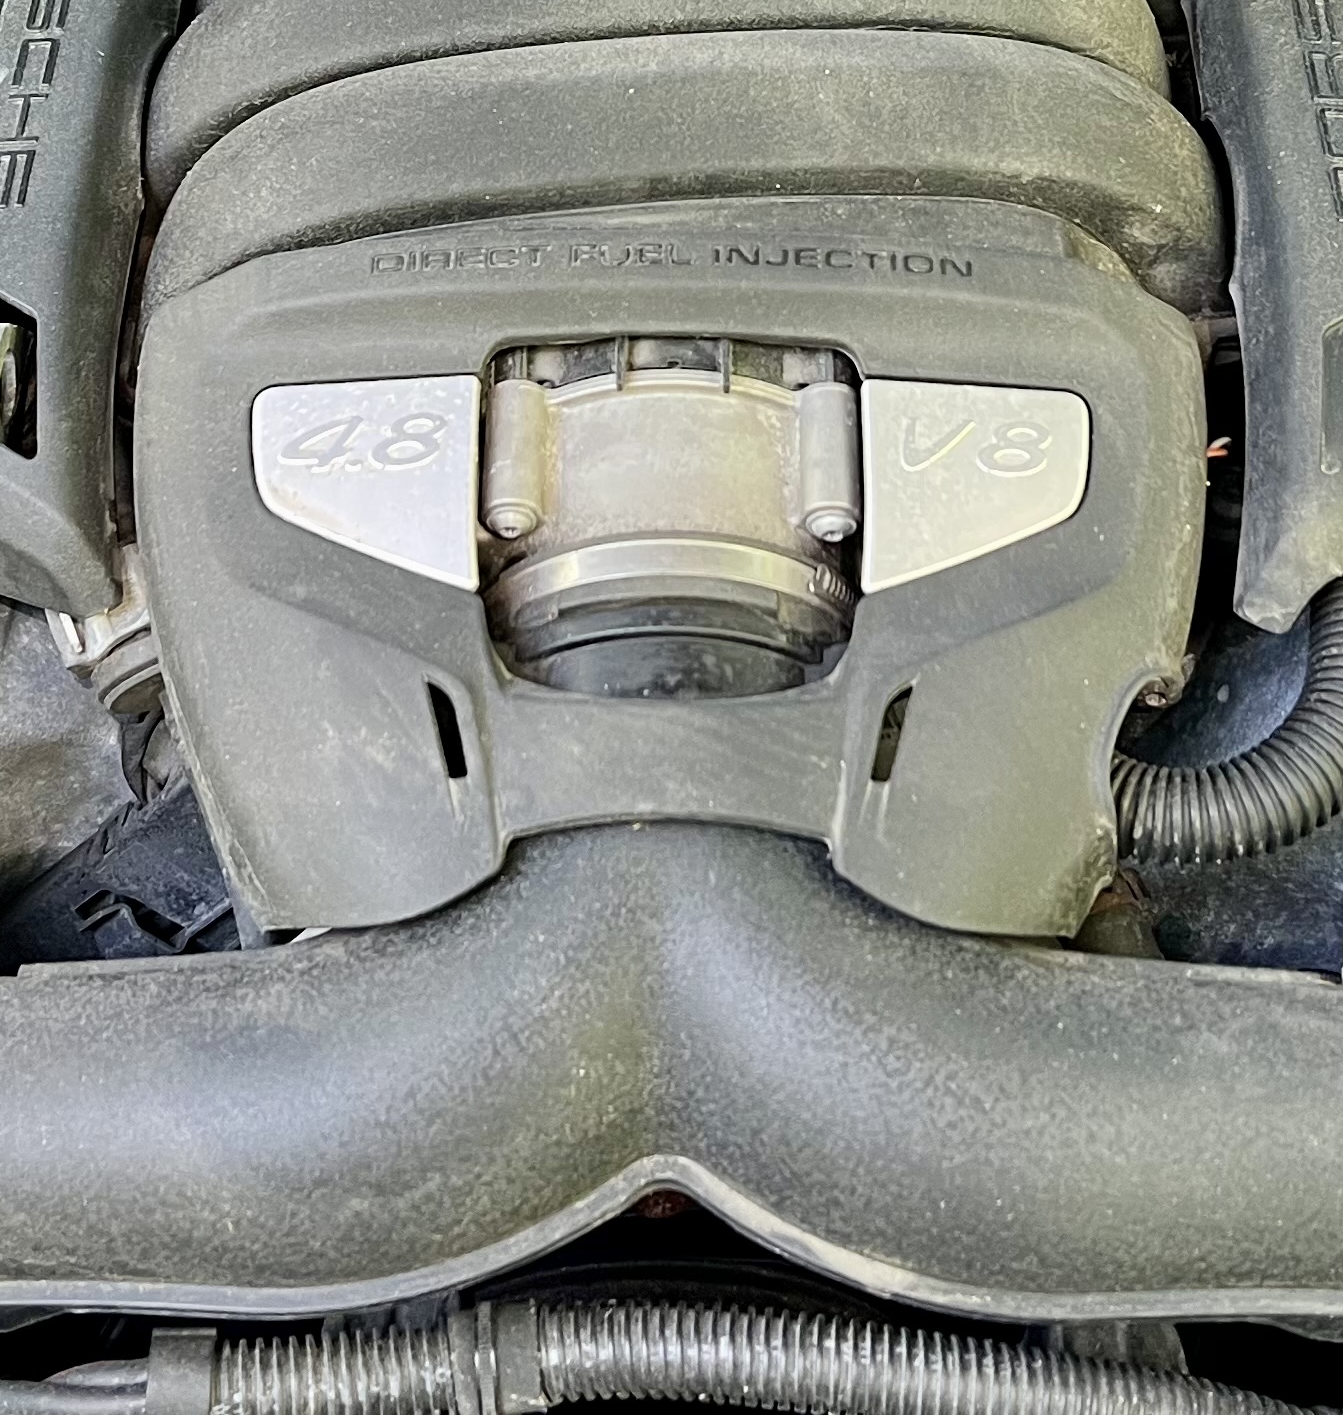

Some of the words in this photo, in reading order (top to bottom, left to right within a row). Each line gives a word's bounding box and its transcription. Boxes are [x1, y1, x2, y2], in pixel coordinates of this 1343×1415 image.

[369, 244, 555, 276] DIRECT
[570, 242, 696, 269] FUEL
[712, 244, 975, 278] INJECTION
[277, 414, 449, 473] 4.8
[900, 418, 1054, 476] V8
